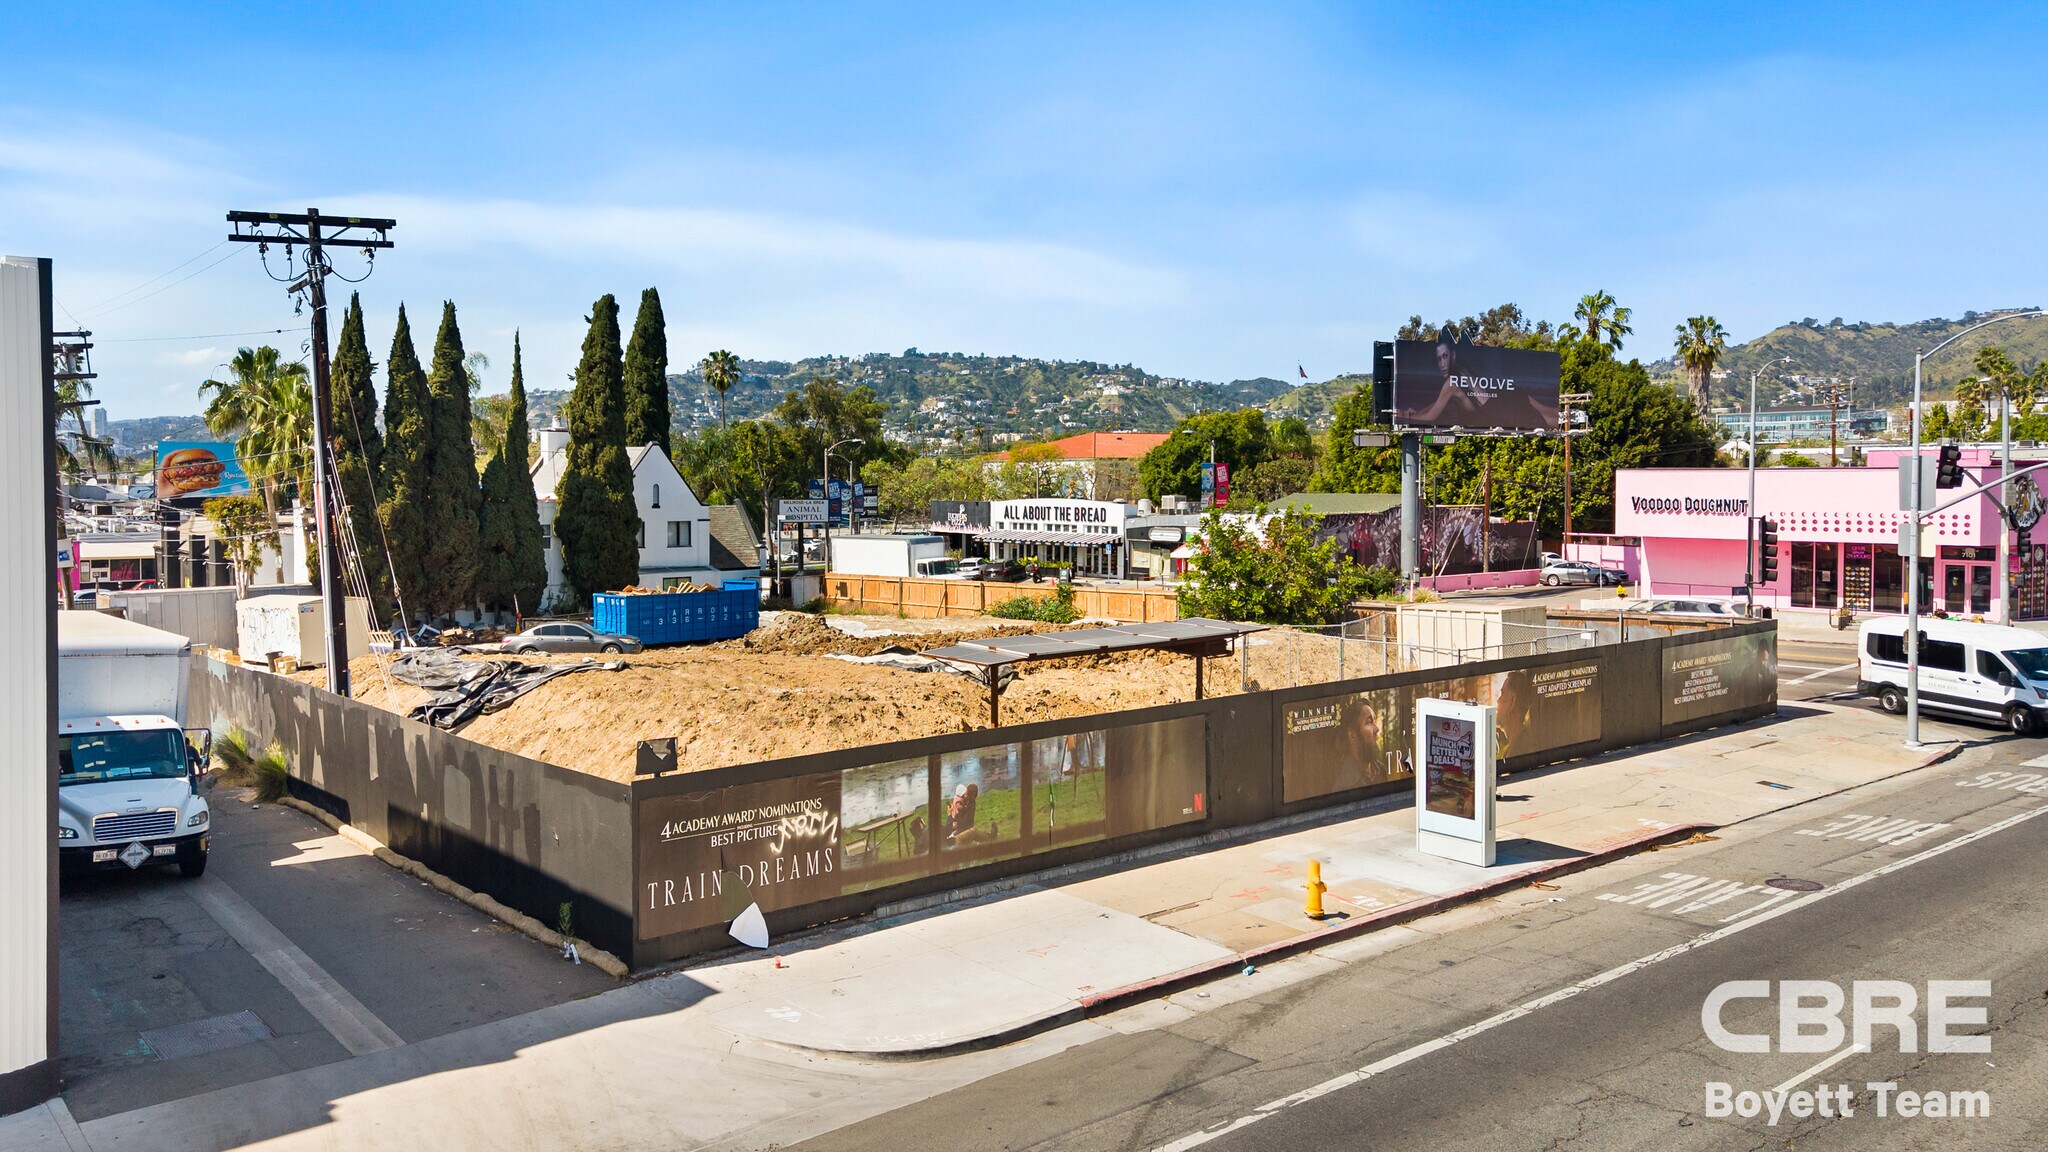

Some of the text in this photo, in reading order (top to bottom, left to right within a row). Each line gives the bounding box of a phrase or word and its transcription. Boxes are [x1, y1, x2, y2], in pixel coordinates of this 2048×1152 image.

[1450, 375, 1515, 390] REVOLVE
[1004, 505, 1107, 523] ALL ABOUT THE BREAD
[1631, 496, 1748, 515] VOODOO DOUGHNUT
[1532, 674, 1537, 684] 4
[1537, 672, 1556, 682] ACADEMY
[1570, 665, 1598, 677] NOMINATIONS
[1537, 678, 1593, 694] BEST ADAPTED SCREENPLAY
[1294, 705, 1335, 719] WINNER
[1432, 736, 1457, 749] MUNCH
[1432, 746, 1457, 757] BETTER
[1433, 756, 1455, 765] DEALS
[661, 821, 671, 838] 4
[672, 815, 720, 834] ACADEMY
[758, 798, 822, 819] NOMINATIONS
[711, 824, 778, 847] BEST PICTURE
[1795, 814, 1951, 846] BIKE
[647, 848, 833, 910] TRAIN DREAMS
[1595, 872, 1800, 923] LANE
